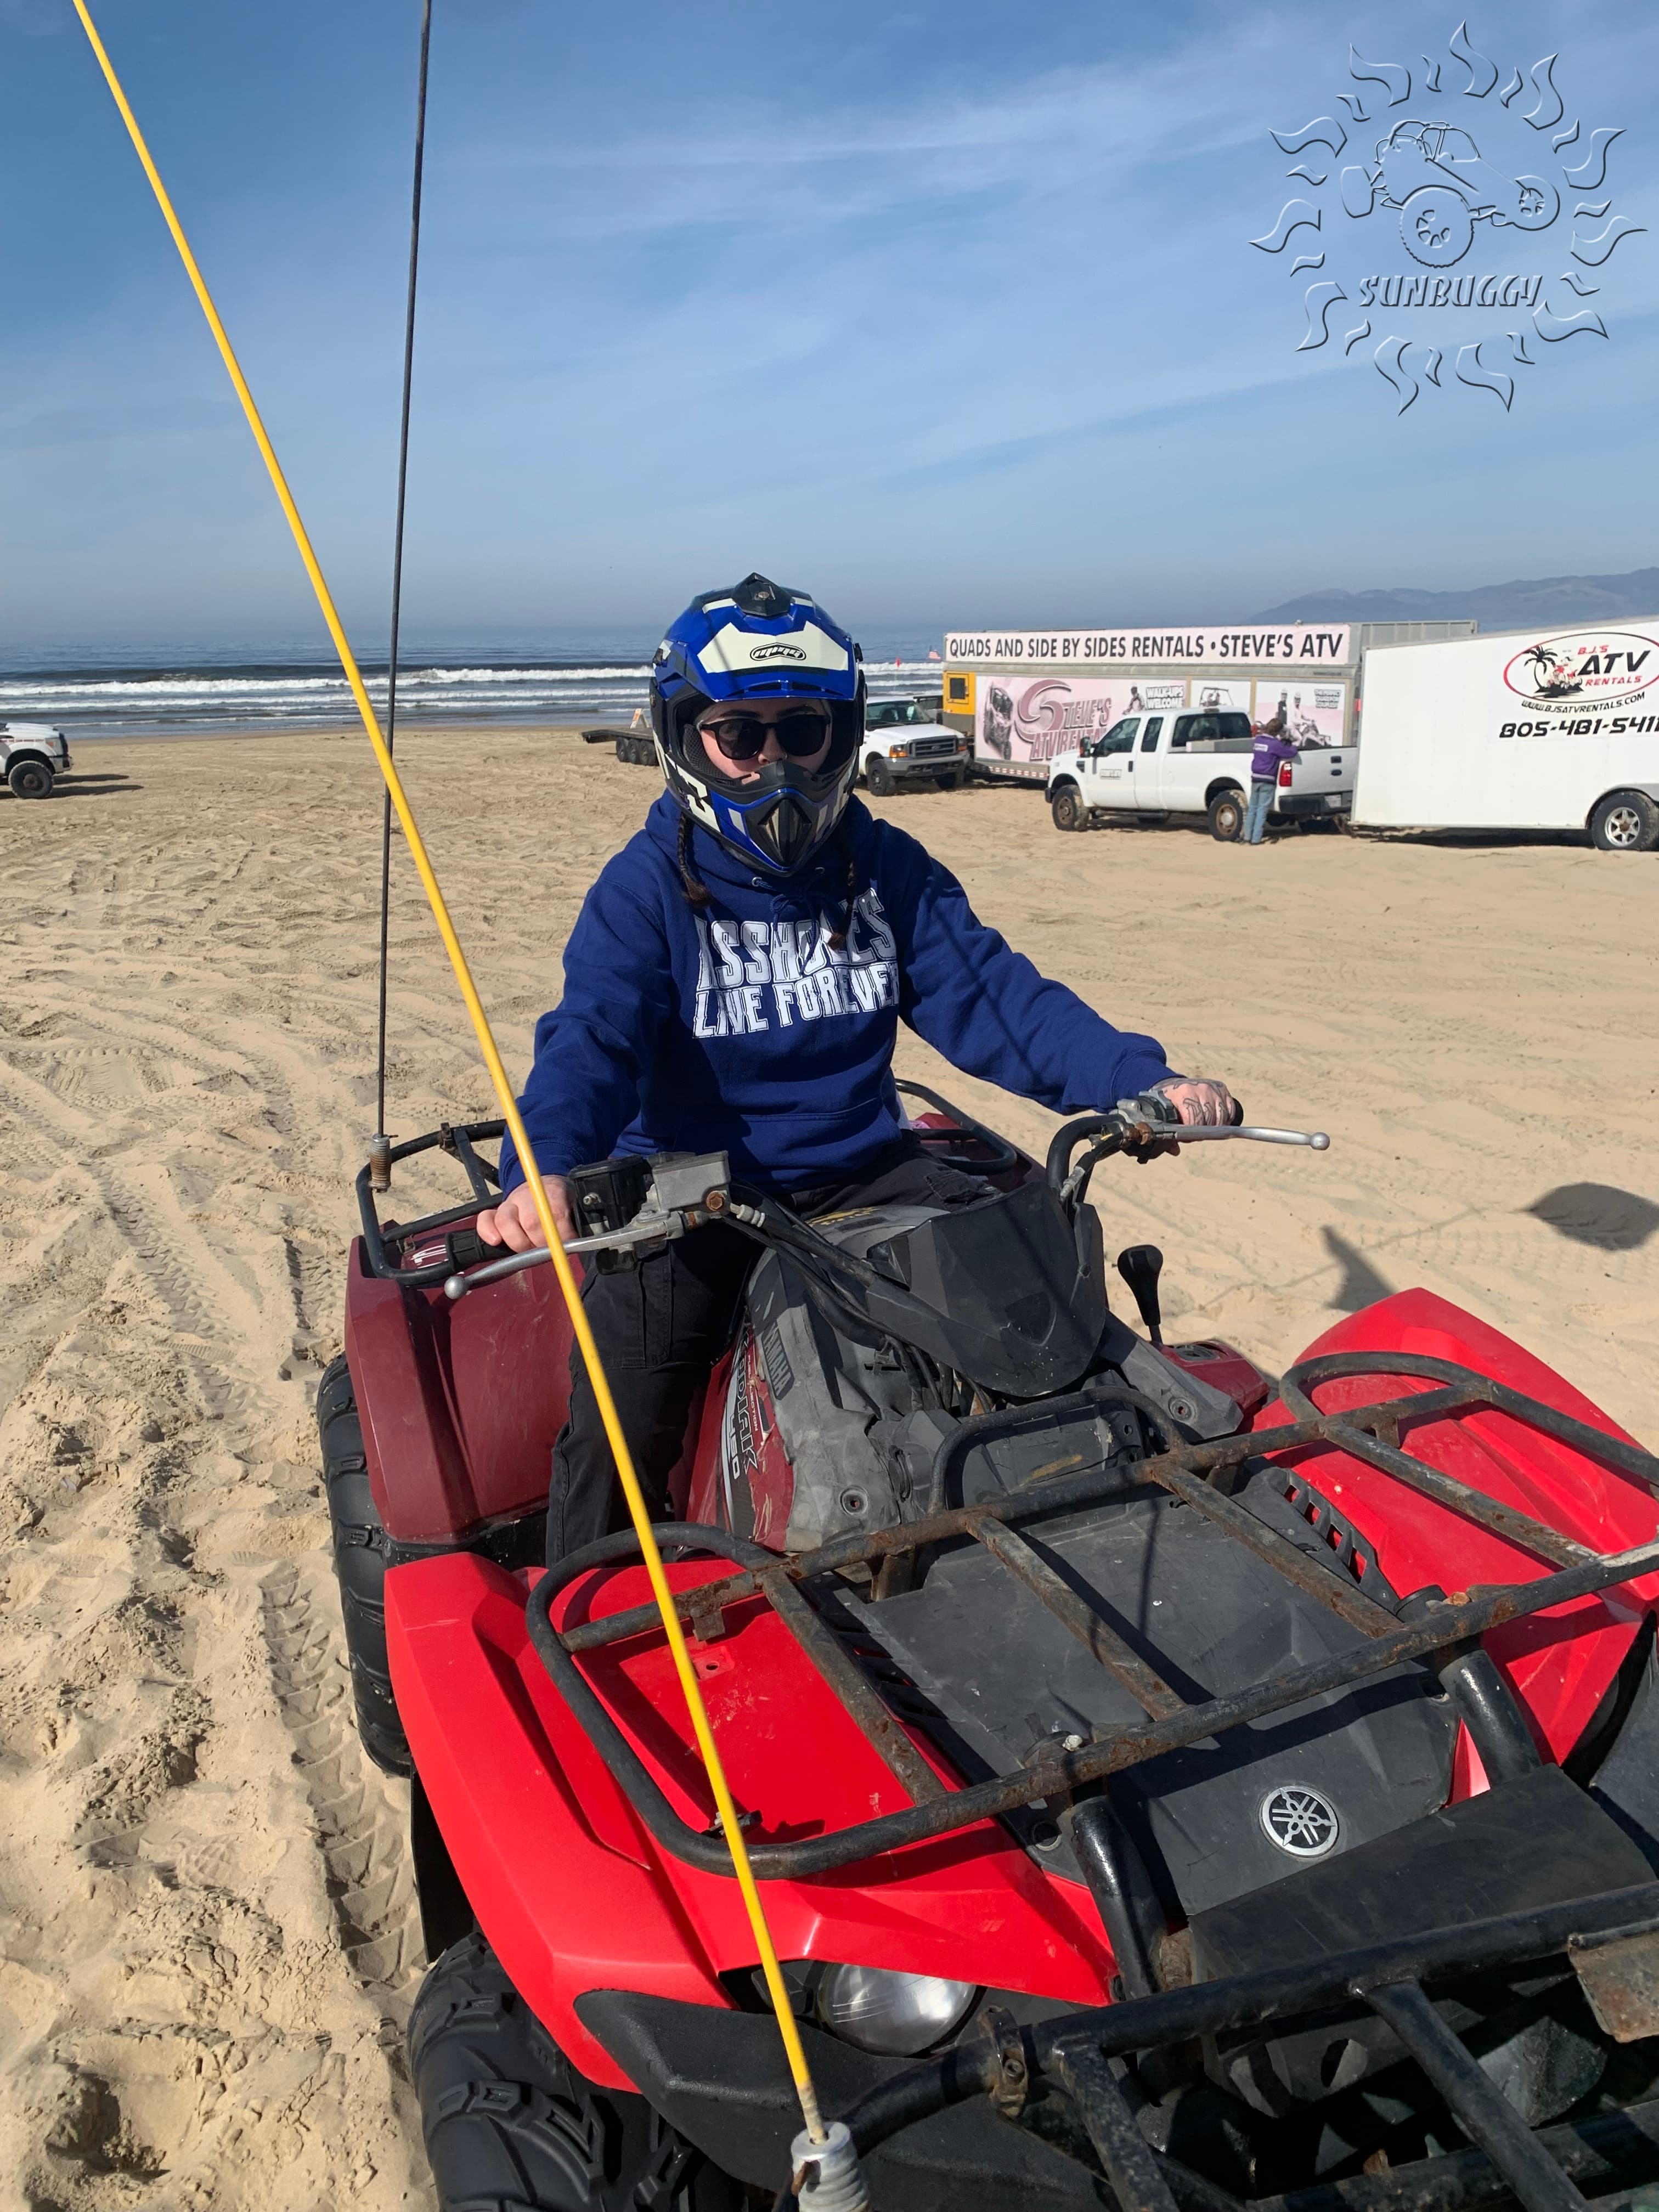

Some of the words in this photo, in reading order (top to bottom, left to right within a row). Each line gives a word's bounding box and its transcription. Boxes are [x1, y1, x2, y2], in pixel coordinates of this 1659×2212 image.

[950, 638, 991, 658] QUADS
[995, 638, 1024, 657] AND
[1028, 637, 1058, 657] SIDE
[1062, 637, 1081, 657] BY
[1084, 636, 1127, 657] SIDES
[1132, 635, 1205, 657] RENTALS
[1219, 633, 1294, 657] STEVE'S
[1300, 633, 1344, 657] ATV
[1577, 650, 1651, 676] ATV
[1585, 675, 1643, 686] RENTALS
[1521, 691, 1645, 714] WWW.BJSATVRENTALS.COM
[1029, 730, 1060, 761] ATV
[763, 1322, 791, 1396] YAMAHA
[748, 1380, 758, 1431] NJECTION
[729, 1411, 740, 1480] 450
